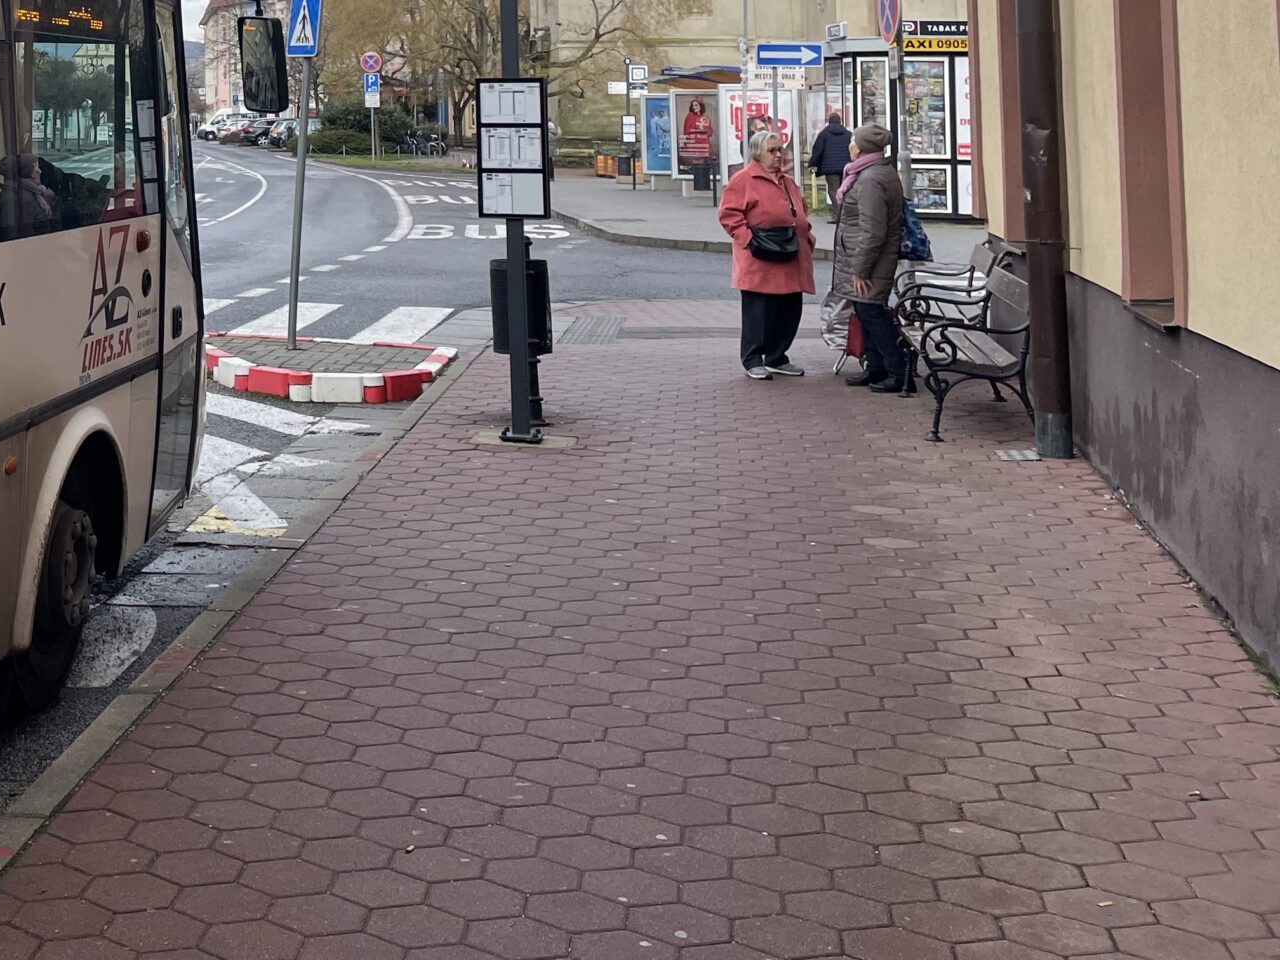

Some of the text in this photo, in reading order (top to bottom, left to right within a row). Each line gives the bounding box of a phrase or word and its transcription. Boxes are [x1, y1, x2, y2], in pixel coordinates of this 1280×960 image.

[927, 24, 957, 32] TABAK
[904, 39, 968, 49] AXI 0905
[406, 224, 570, 239] BUS
